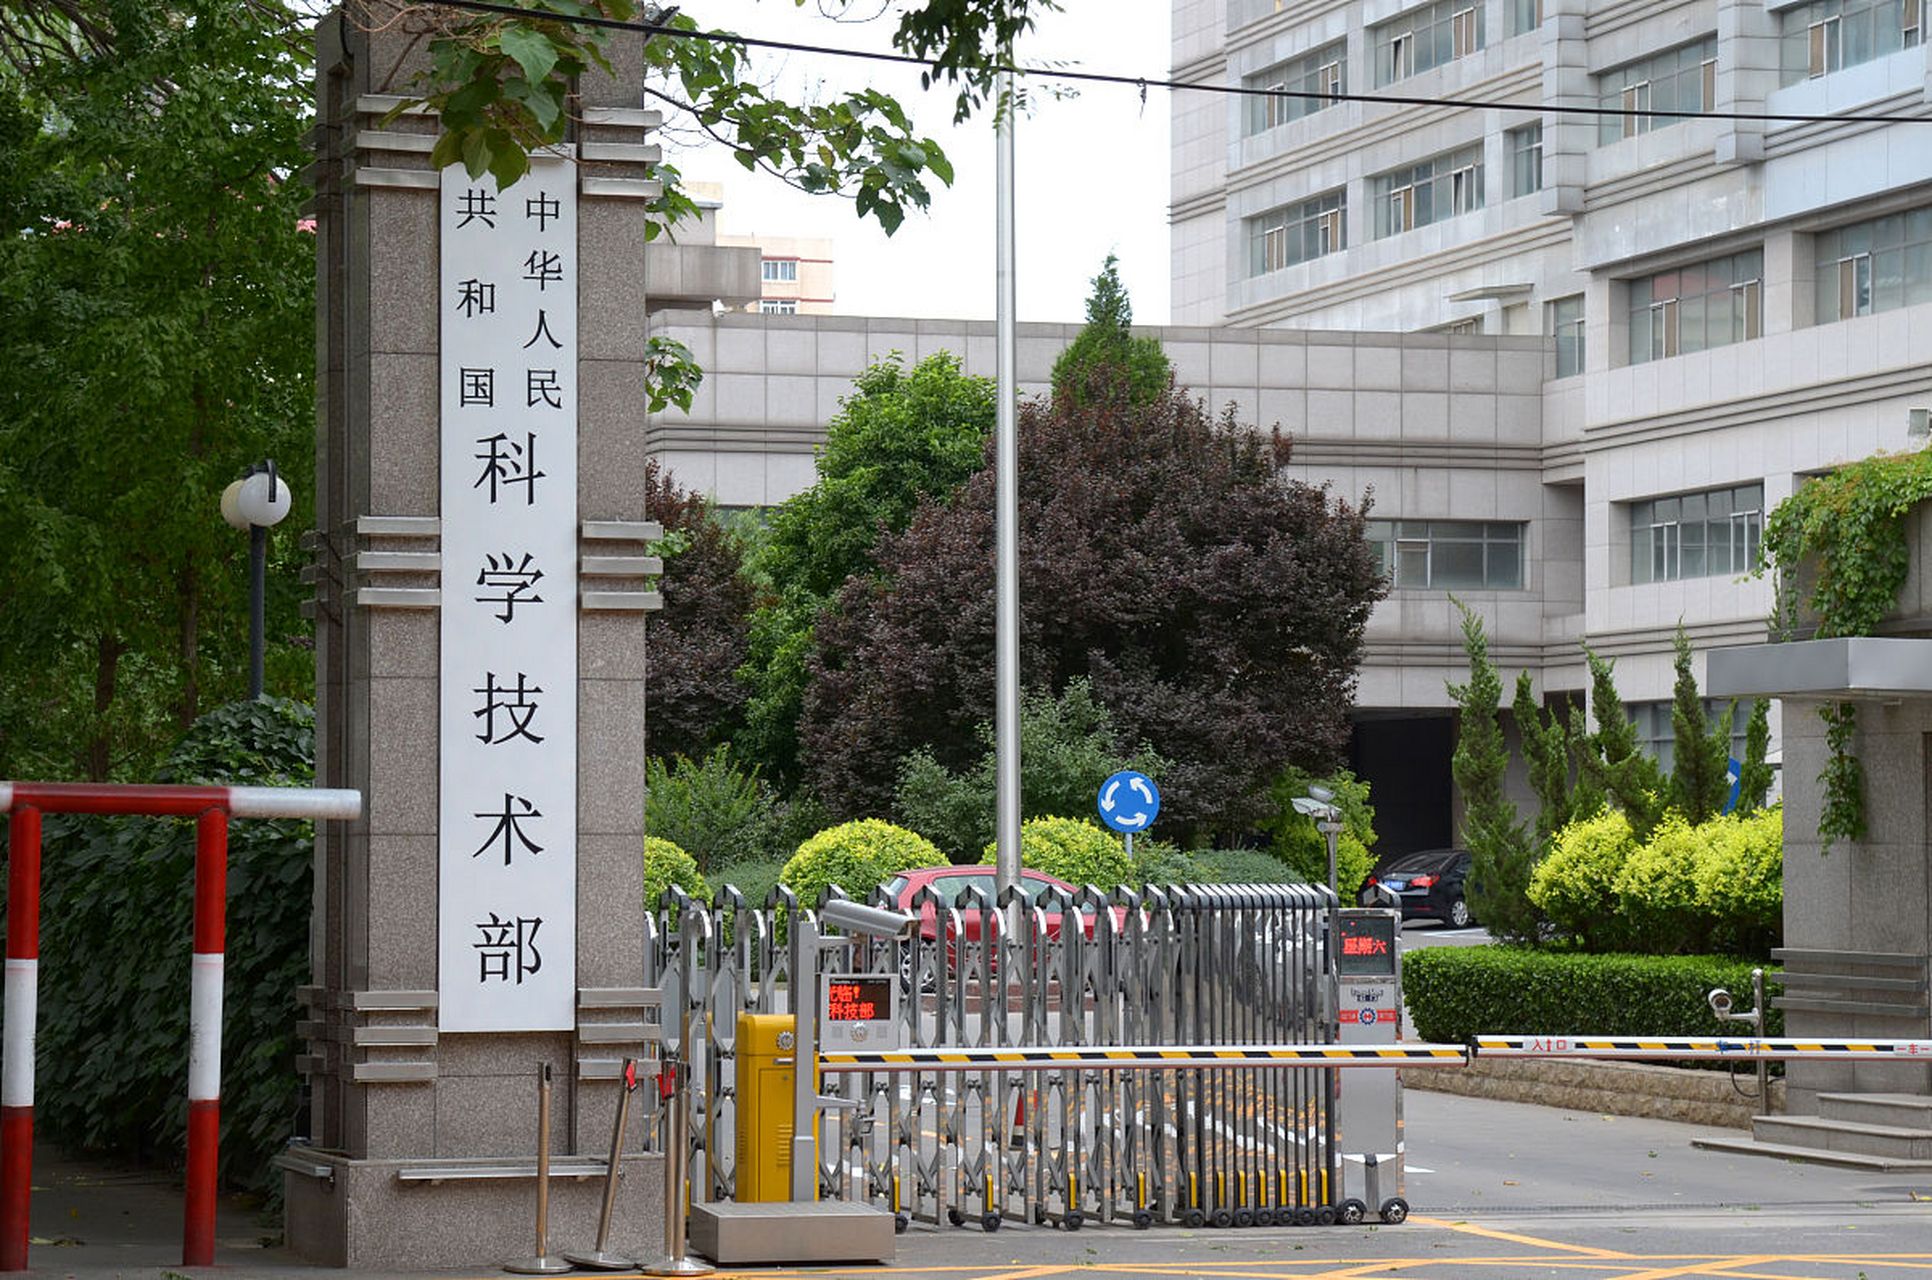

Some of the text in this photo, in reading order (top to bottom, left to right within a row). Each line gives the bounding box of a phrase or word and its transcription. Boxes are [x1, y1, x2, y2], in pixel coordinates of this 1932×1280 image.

[456, 188, 498, 408] 共和国
[523, 190, 563, 410] 中华人民
[473, 431, 546, 985] 科学技术部
[1343, 937, 1387, 955] 星期六
[829, 1001, 875, 1020] 科技部
[1531, 1039, 1568, 1052] 入口
